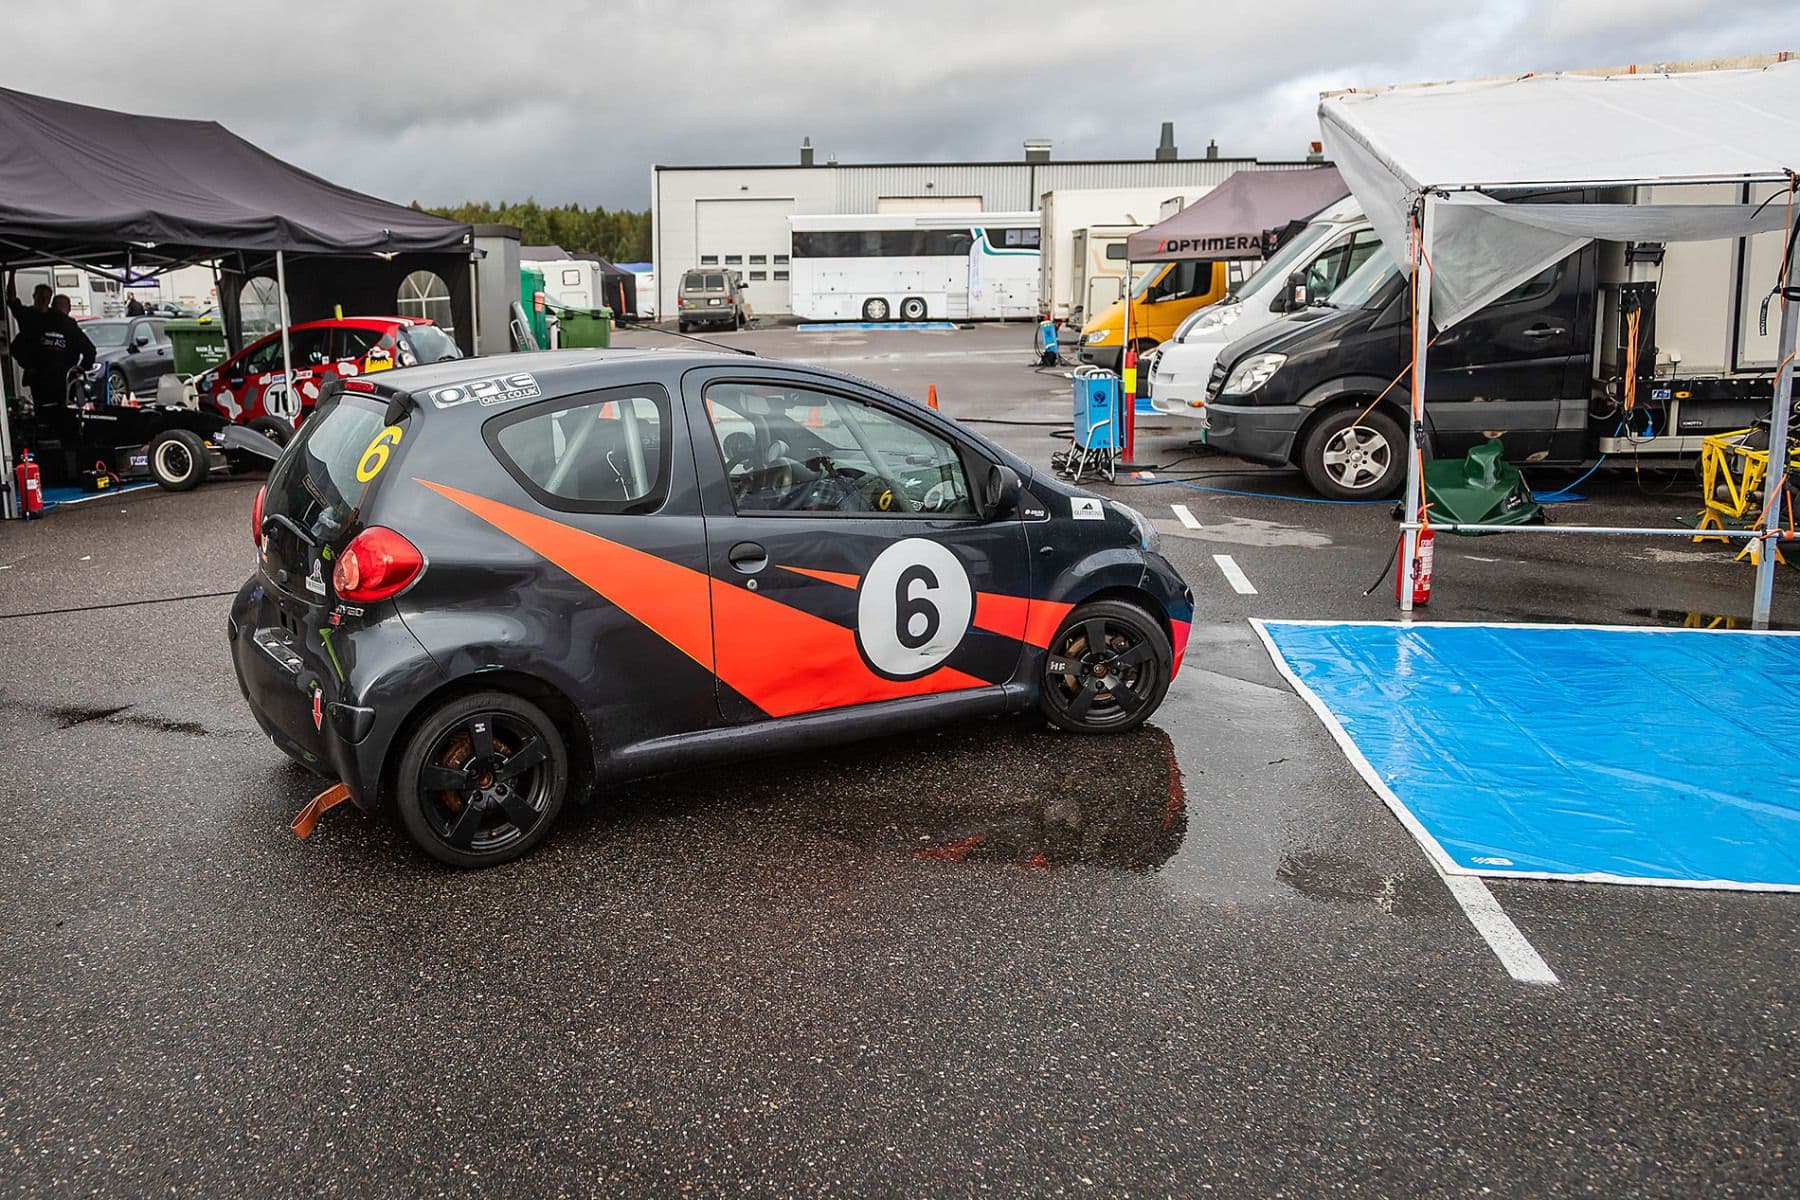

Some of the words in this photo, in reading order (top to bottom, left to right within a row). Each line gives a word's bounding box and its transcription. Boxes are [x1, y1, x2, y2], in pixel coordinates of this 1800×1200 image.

[1166, 236, 1263, 253] OPTIMERA
[435, 373, 534, 404] OPIE
[355, 425, 403, 483] 6
[879, 489, 893, 511] 6
[895, 564, 941, 649] 6
[1050, 661, 1066, 671] HF
